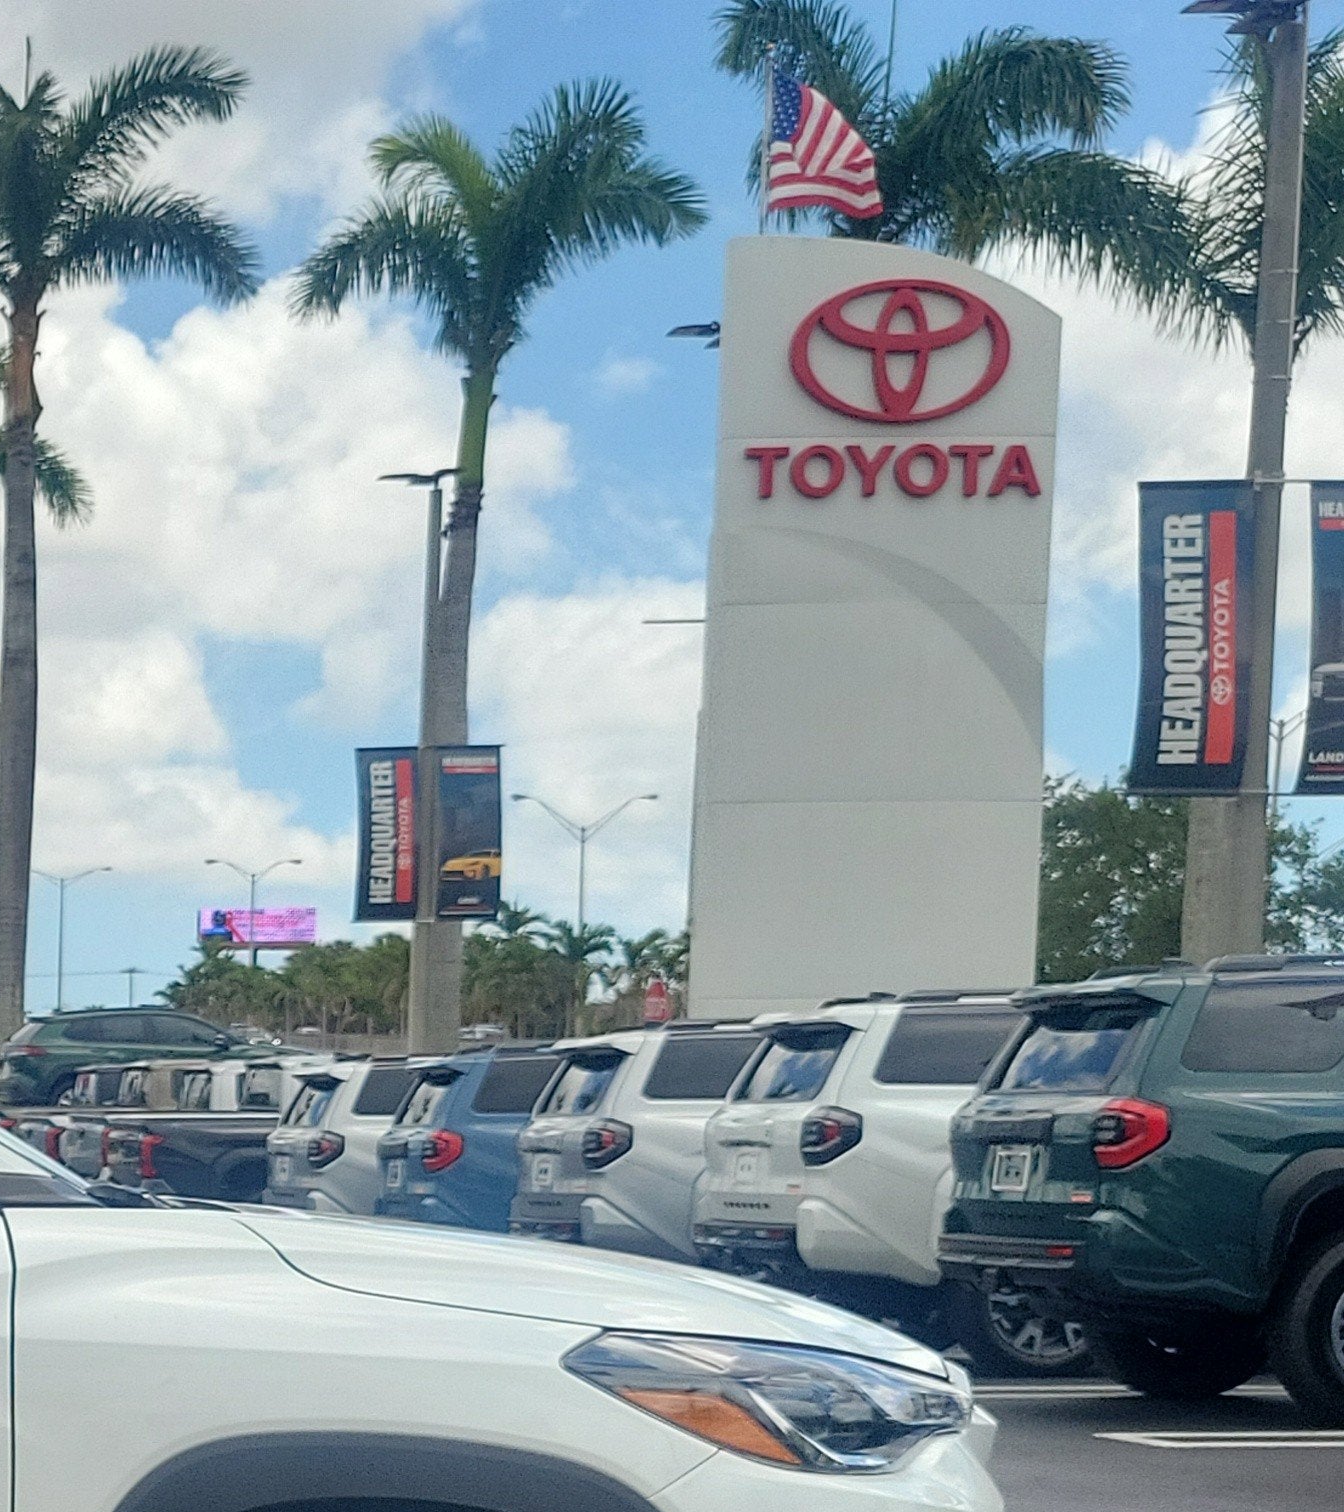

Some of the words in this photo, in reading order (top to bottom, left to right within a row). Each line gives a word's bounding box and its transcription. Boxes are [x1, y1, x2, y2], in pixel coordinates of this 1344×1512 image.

[744, 444, 1041, 499] TOYOTA
[1157, 513, 1208, 765] HEADQUARTER
[1213, 579, 1233, 673] TOYOTA
[369, 761, 396, 904] HEADQUARTER
